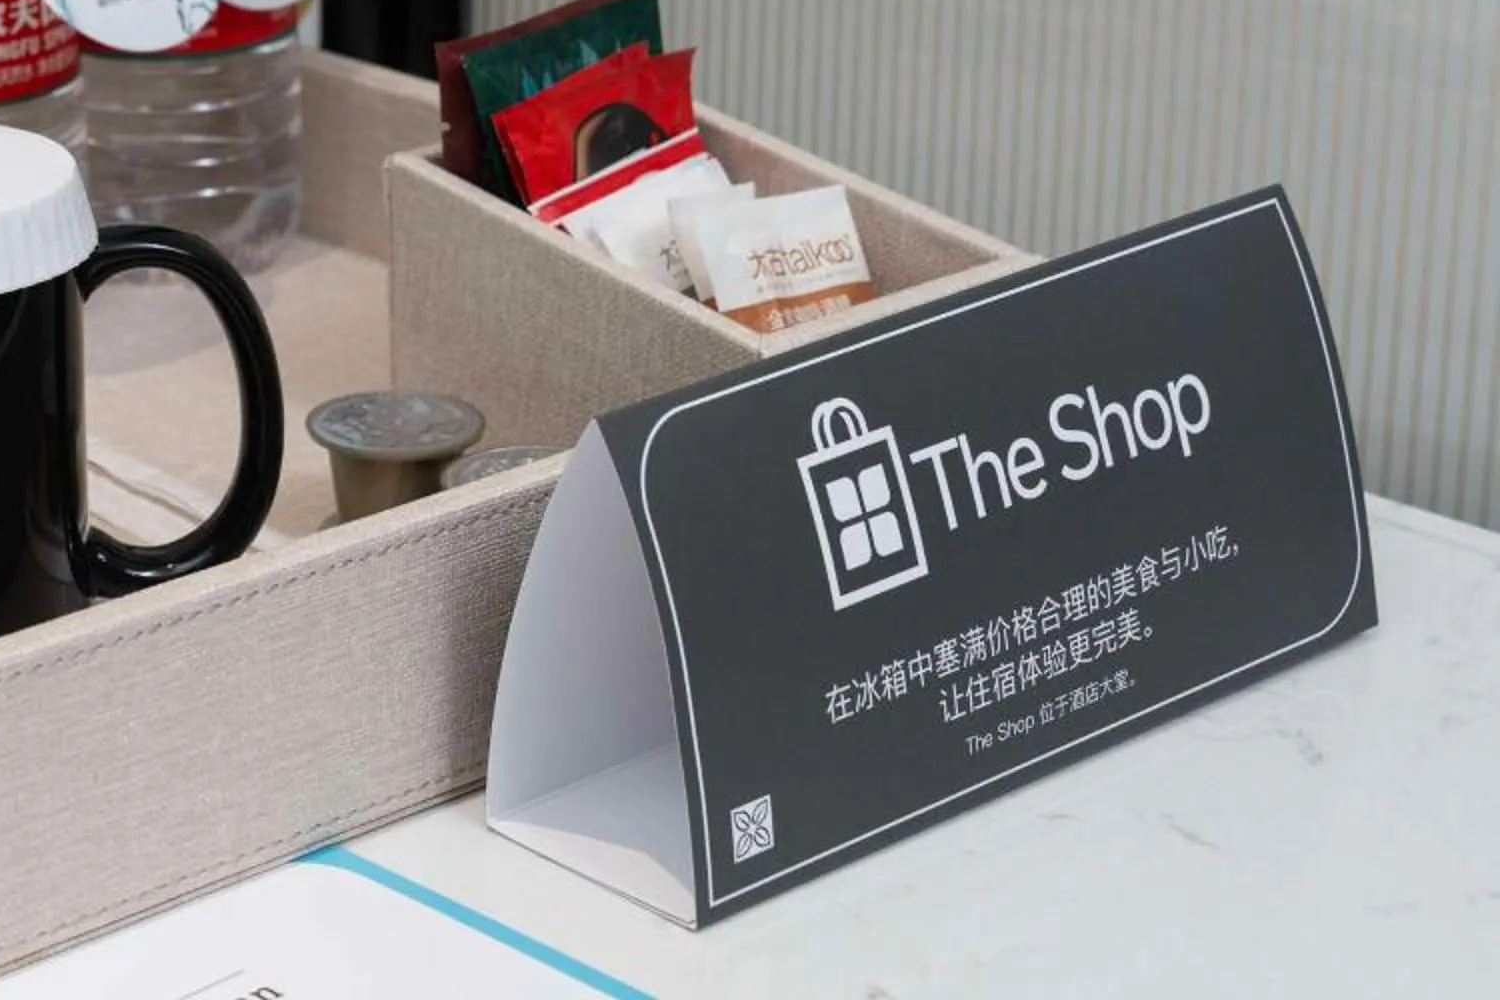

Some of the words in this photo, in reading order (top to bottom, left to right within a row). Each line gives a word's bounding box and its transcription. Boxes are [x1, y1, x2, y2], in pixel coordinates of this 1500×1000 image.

[909, 433, 1048, 532] The
[1049, 373, 1211, 482] Shop
[938, 607, 1154, 723] 让住宿体验更完美。
[965, 731, 994, 757] The
[997, 713, 1036, 742] Shop
